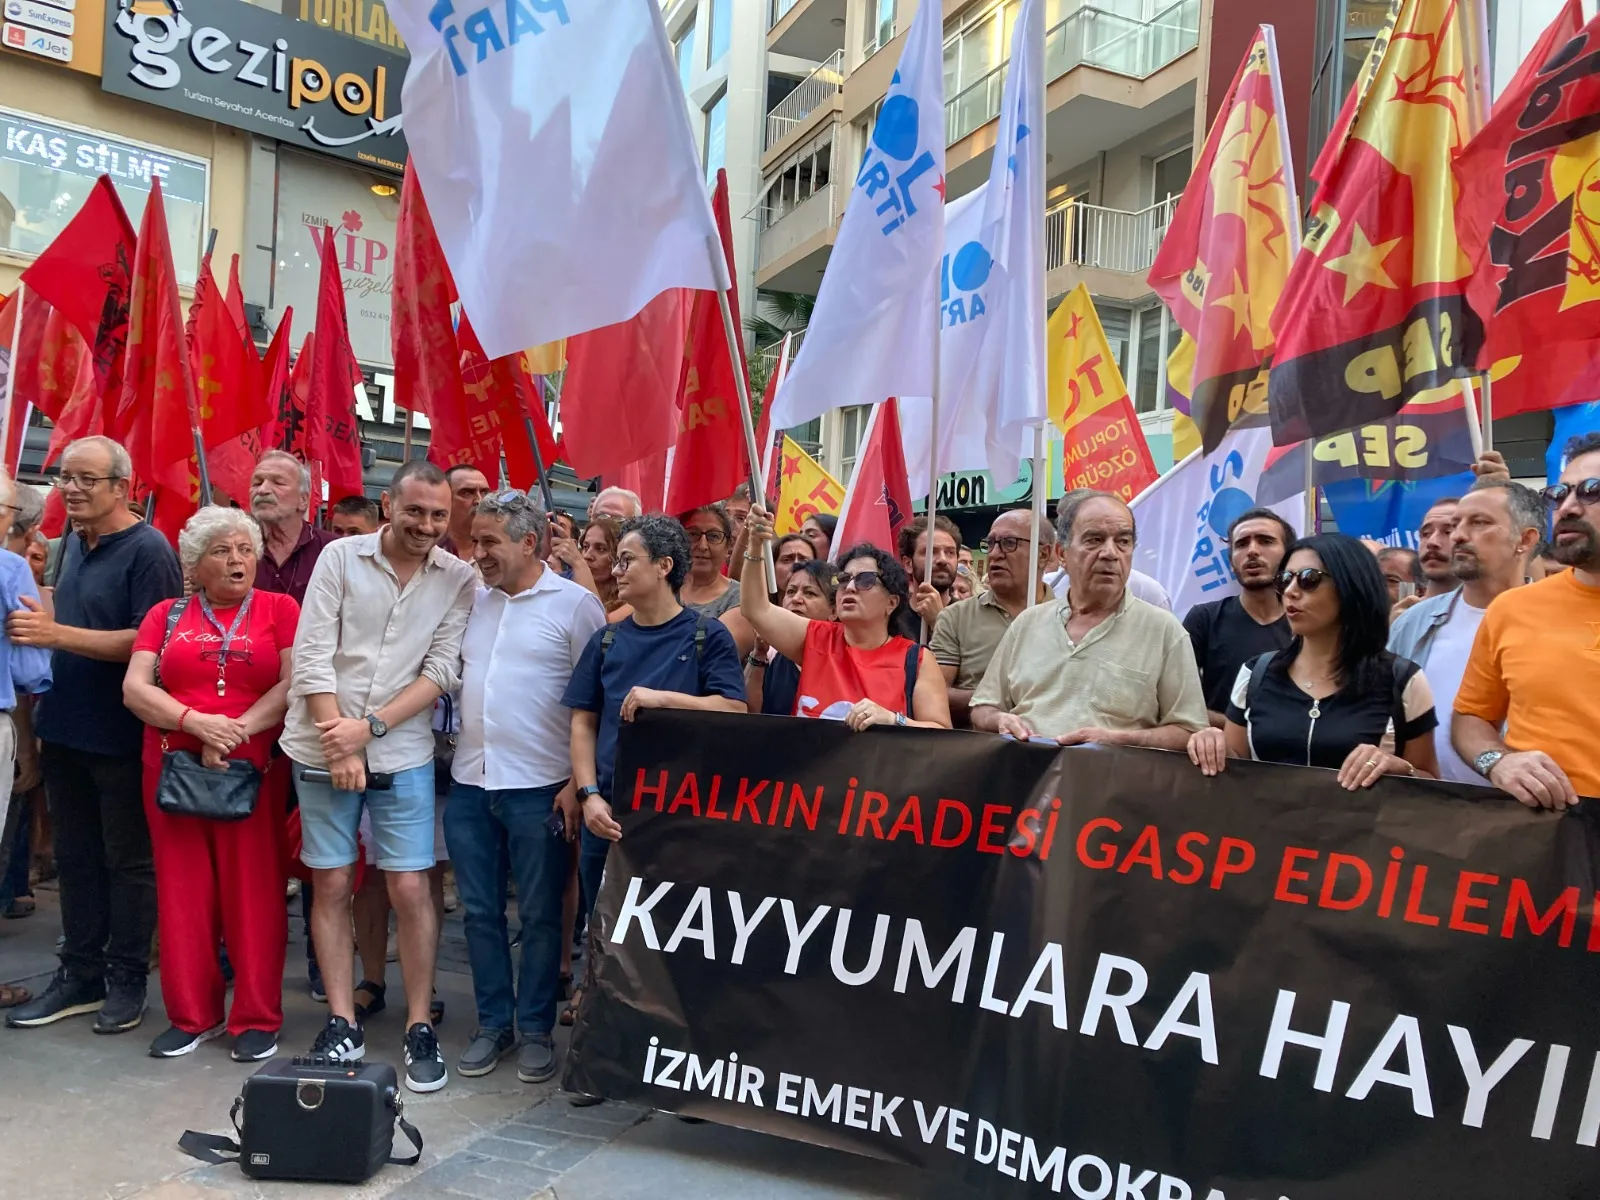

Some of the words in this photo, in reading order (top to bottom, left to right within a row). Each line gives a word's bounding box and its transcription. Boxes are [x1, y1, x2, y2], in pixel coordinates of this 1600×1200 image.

[28, 9, 72, 29] SunExpress
[116, 8, 386, 121] gezipol
[183, 88, 213, 104] Turizm
[214, 97, 253, 115] Seyahat
[255, 109, 295, 128] Acentası
[6, 127, 68, 167] KAŞ
[75, 143, 171, 187] SİLME
[360, 309, 377, 319] 0532
[631, 767, 822, 831] HALKIN
[837, 777, 1062, 861] İRADESİ
[1075, 817, 1257, 891] GASP
[610, 876, 1220, 1066] KAYYUMLARA
[641, 1036, 766, 1104] İZMİR
[775, 1072, 904, 1137] EMEK
[912, 1099, 970, 1154] VE
